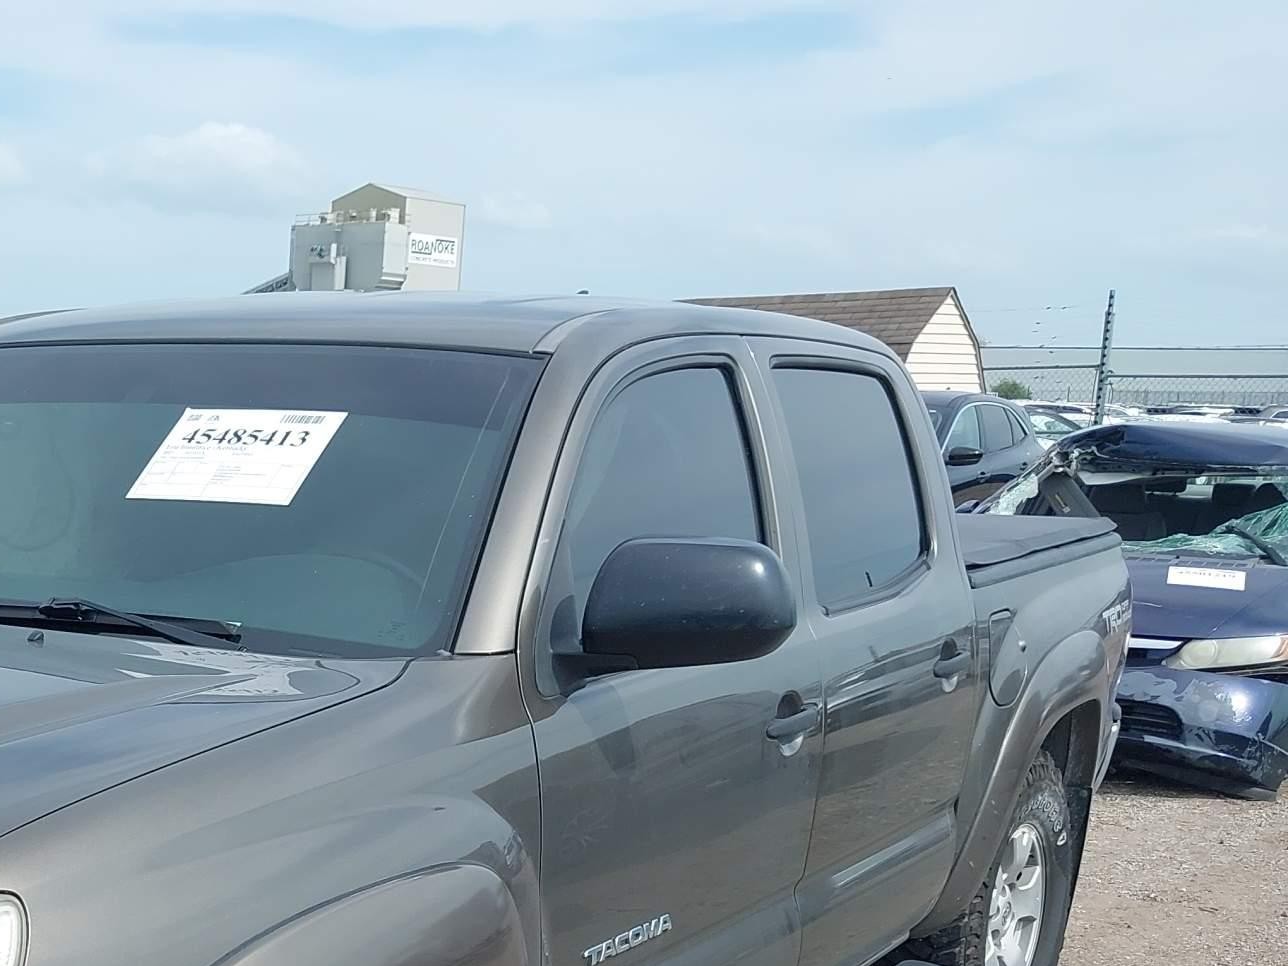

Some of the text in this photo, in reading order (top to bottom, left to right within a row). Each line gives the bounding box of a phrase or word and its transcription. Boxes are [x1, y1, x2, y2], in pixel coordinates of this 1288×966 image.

[411, 239, 455, 255] ROANOKE
[182, 428, 311, 447] 45485413
[582, 913, 673, 966] TACOMA
